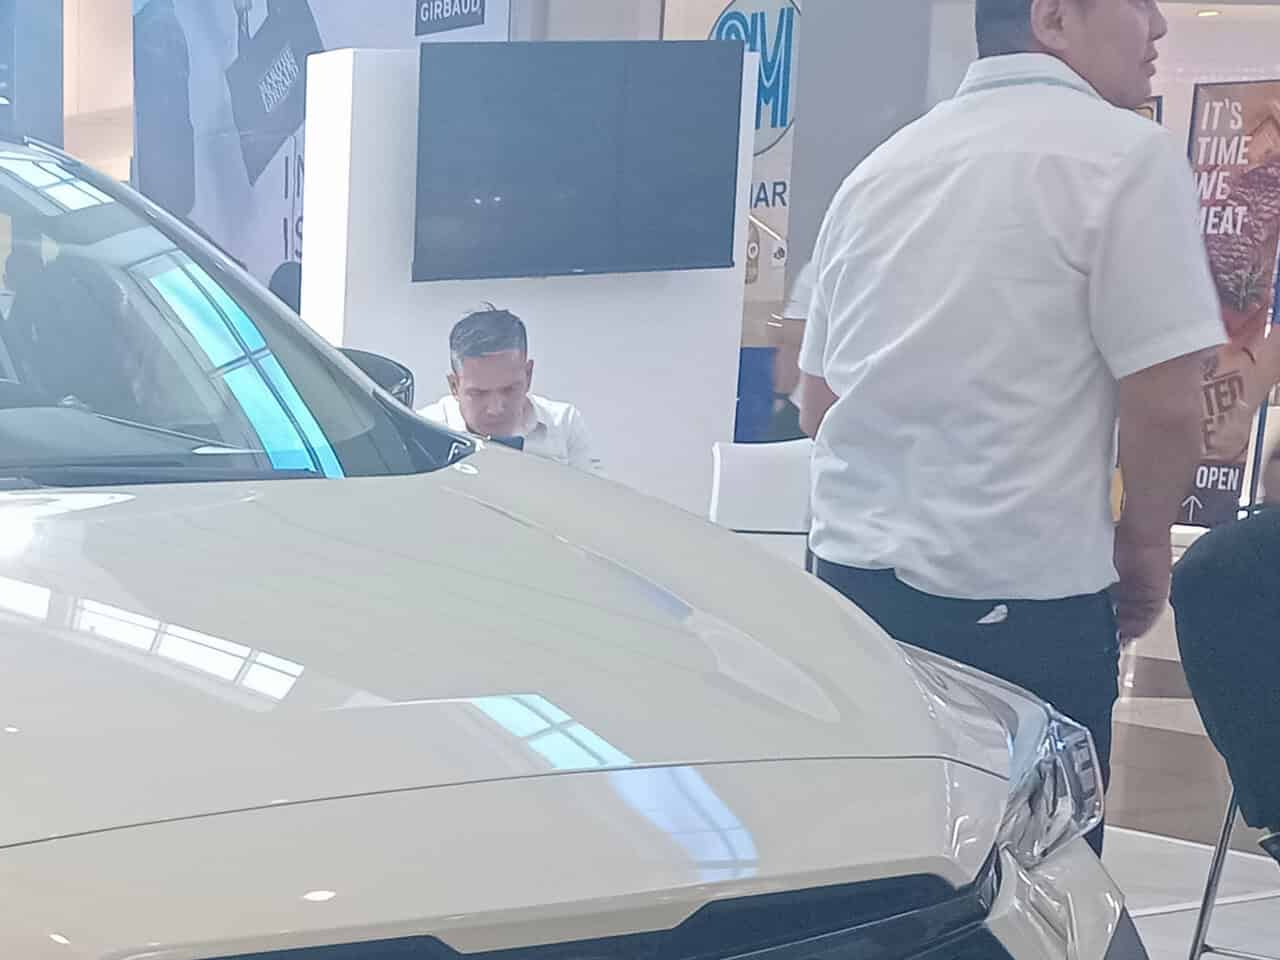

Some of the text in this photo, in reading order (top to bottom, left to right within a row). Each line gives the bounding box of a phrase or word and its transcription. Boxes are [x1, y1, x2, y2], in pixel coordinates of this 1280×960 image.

[421, 0, 480, 21] GIRBAUD
[1201, 98, 1243, 131] IT'S
[1197, 135, 1253, 165] TIME
[749, 181, 787, 209] AR
[1194, 170, 1231, 200] WE
[1195, 465, 1240, 491] OPEN
